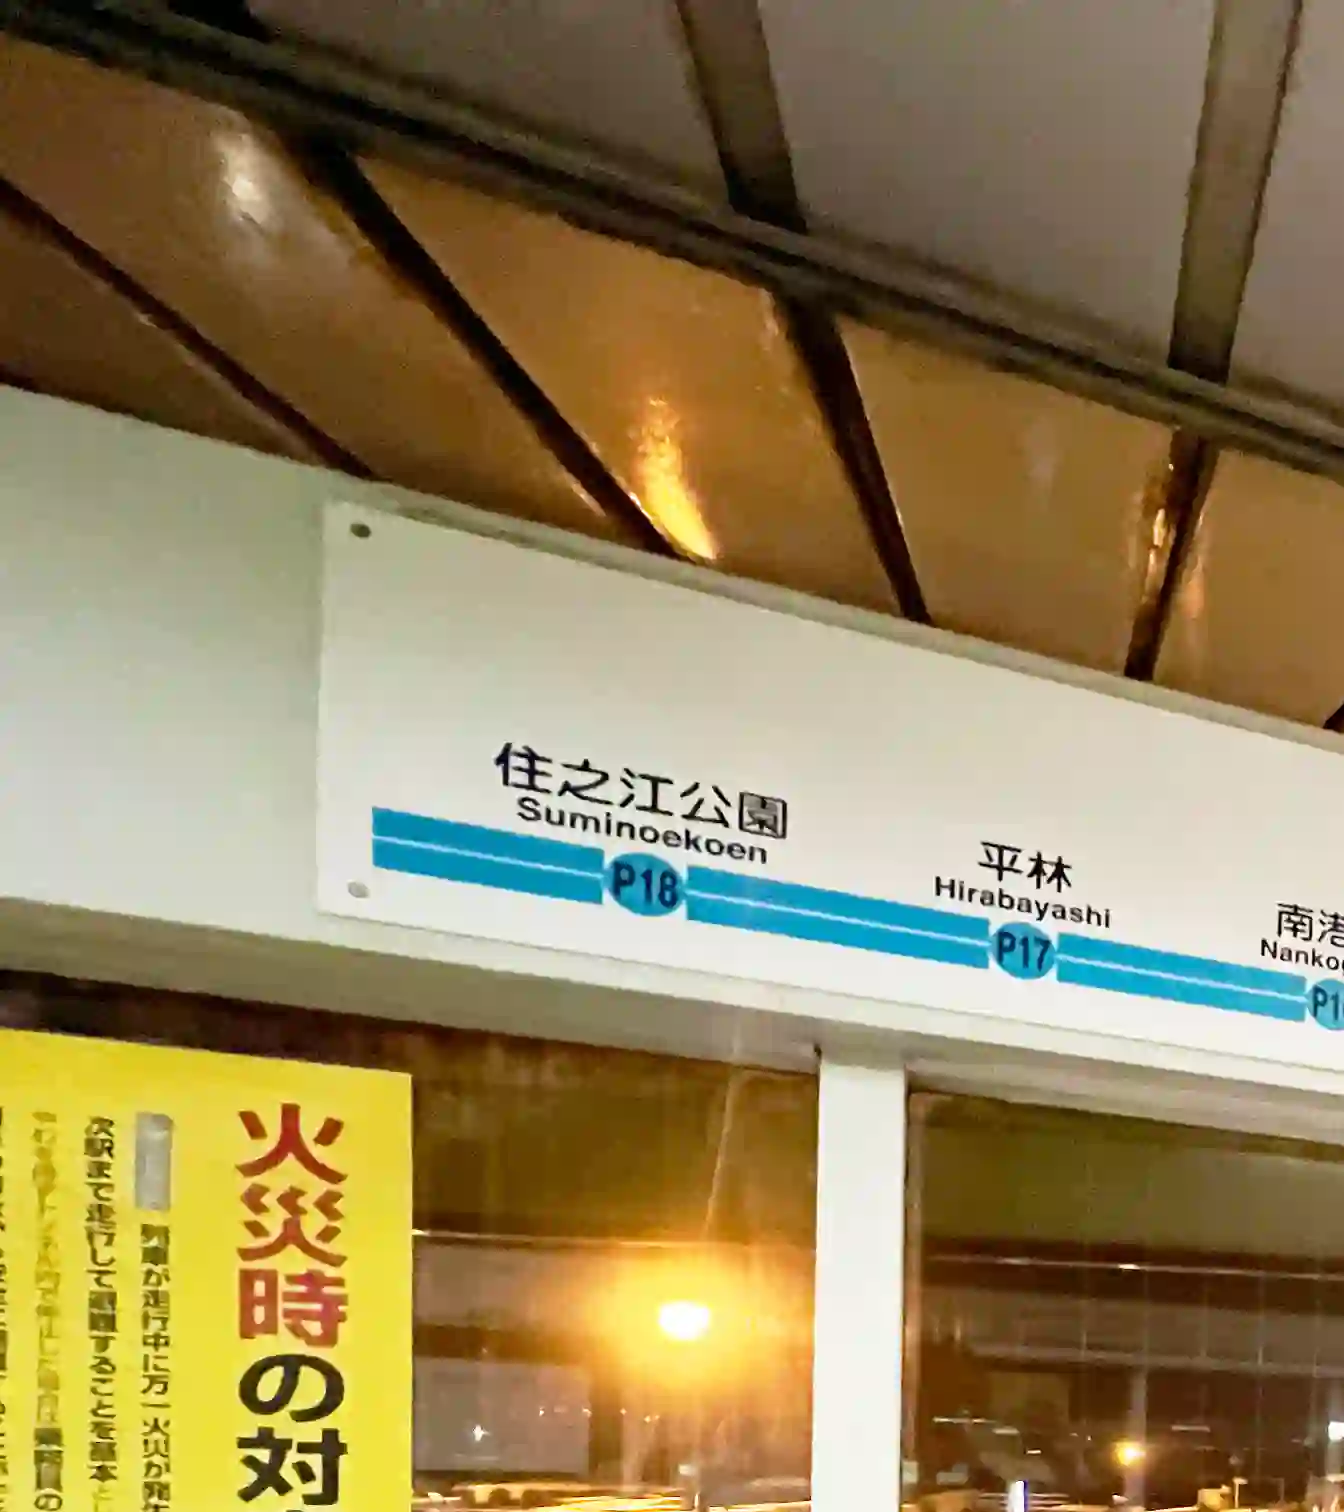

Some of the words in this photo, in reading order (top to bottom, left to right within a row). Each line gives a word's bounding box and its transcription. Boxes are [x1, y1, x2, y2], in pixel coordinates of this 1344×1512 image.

[495, 740, 787, 840] 住之江公園
[516, 796, 768, 865] Suminoekoen
[610, 860, 679, 910] P18
[978, 841, 1073, 893] 平林
[934, 876, 1112, 930] Hirabayashi
[994, 930, 1051, 972] P17
